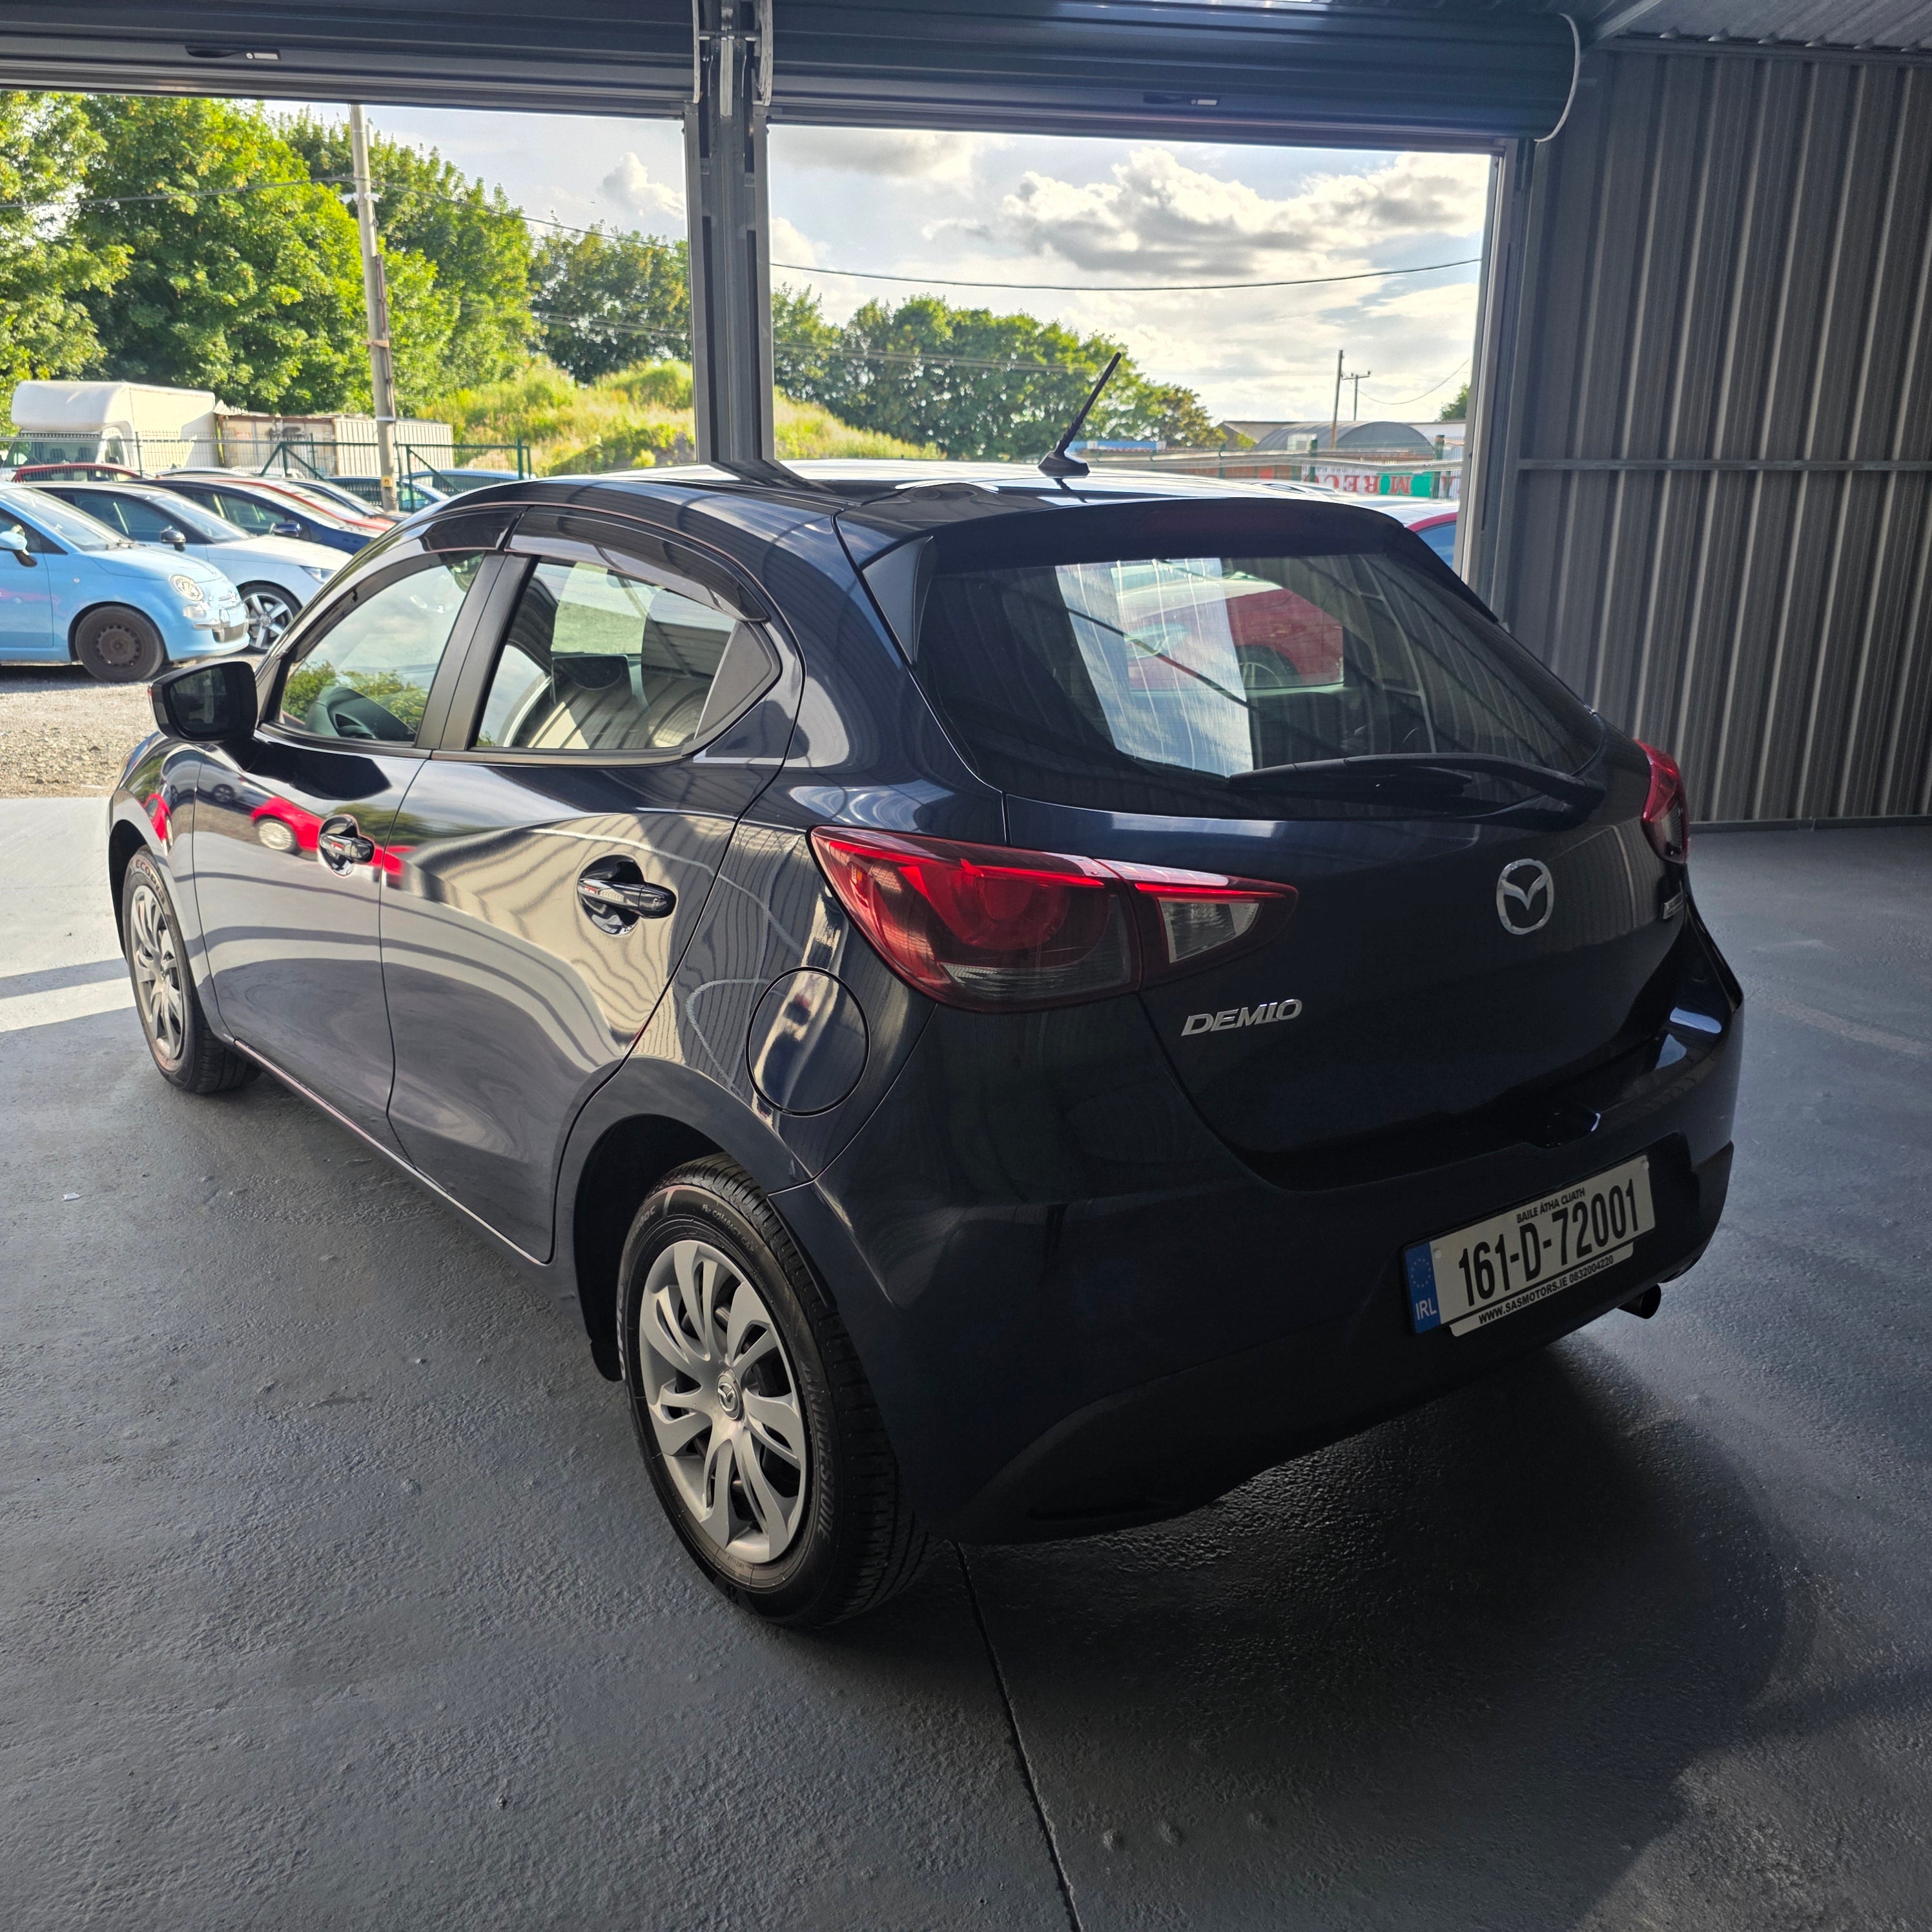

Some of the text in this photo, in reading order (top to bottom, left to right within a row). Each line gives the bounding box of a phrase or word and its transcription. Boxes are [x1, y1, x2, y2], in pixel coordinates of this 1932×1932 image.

[1180, 998, 1303, 1037] DEMIO
[1516, 1186, 1586, 1224] BAILE ÁTHA CLIATH
[1458, 1178, 1639, 1307] 161-D-72001
[1414, 1298, 1438, 1321] IRL
[1477, 1254, 1614, 1324] WWW.SASMOTORS.IE 0832004220
[800, 1360, 836, 1544] BRIDGESTONE
